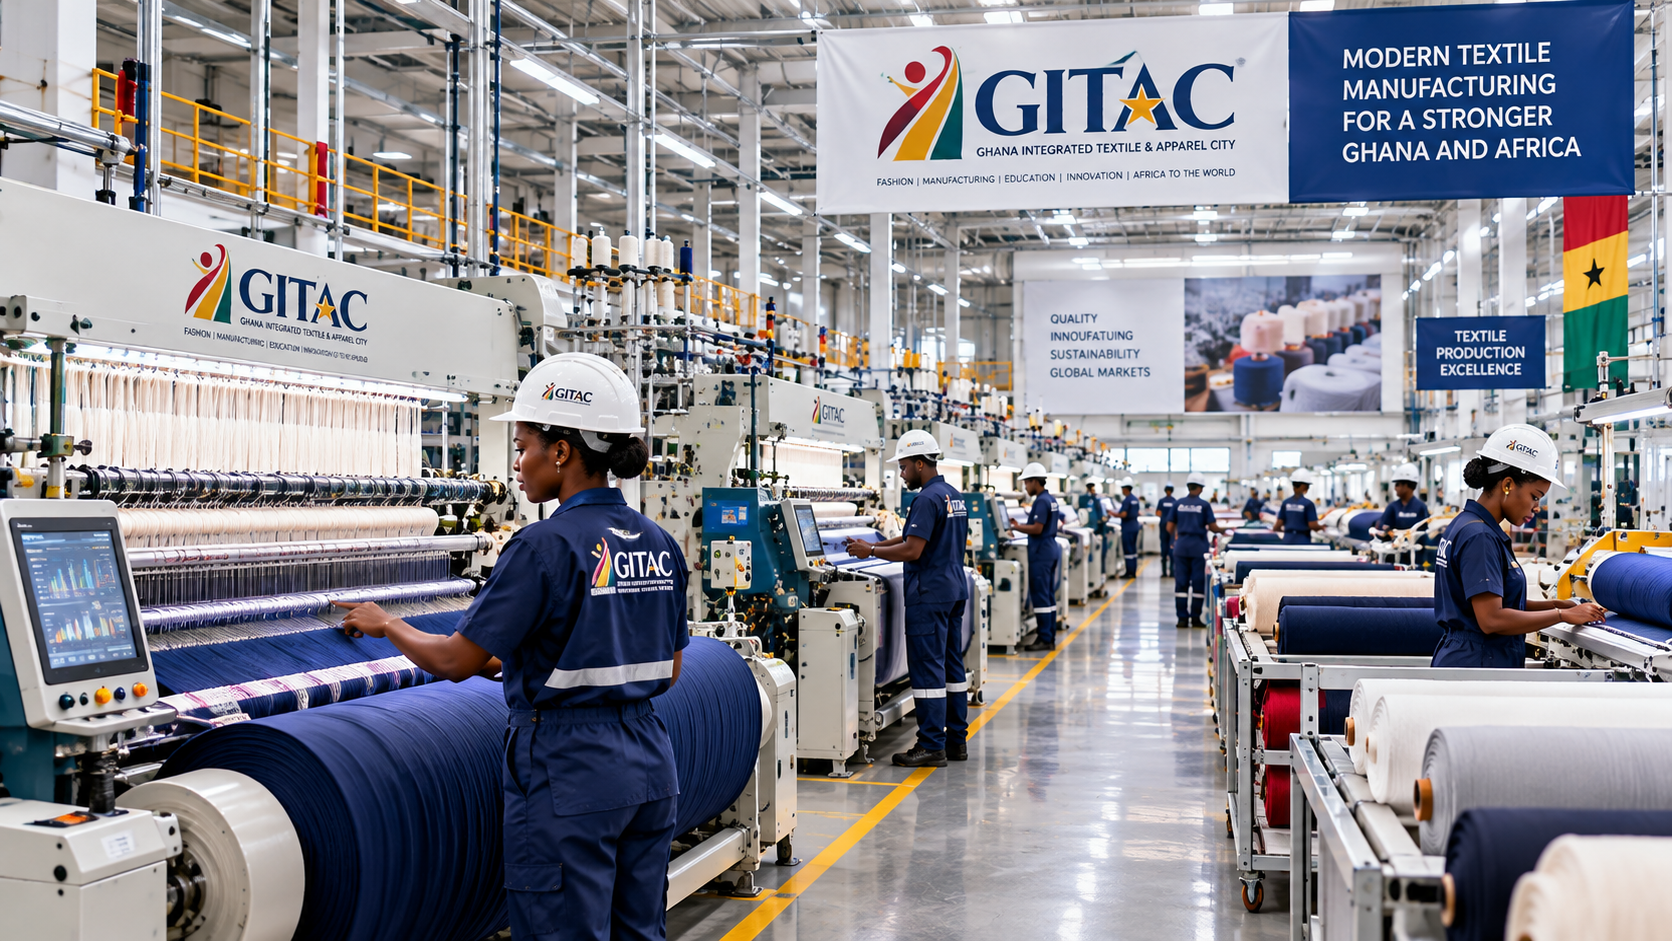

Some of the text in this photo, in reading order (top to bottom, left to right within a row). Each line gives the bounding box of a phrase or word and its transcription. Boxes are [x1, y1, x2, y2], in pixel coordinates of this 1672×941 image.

[1343, 42, 1551, 69] MODERN TEXTILE
[1343, 73, 1556, 100] MANUFACTURING
[975, 62, 1235, 136] GITAC
[1343, 105, 1553, 132] FOR A STRONGER
[976, 140, 1236, 157] GHANA INTEGRATED TEXTILE & APPAREL CITY
[1342, 136, 1582, 163] GHANA AND AFRICA
[876, 178, 914, 186] FASHION
[922, 176, 995, 185] MANUFACTURING
[1004, 174, 1056, 183] EDUCATION
[1067, 172, 1123, 181] INNOVATION
[1133, 170, 1166, 179] AFRICA
[1169, 169, 1181, 178] TO
[1184, 169, 1200, 178] THE
[1203, 168, 1236, 177] WORLD
[239, 268, 368, 332] GITAC
[1050, 314, 1098, 325] QUALITY
[1454, 330, 1507, 342] TEXTILE
[1050, 349, 1140, 360] SUSTAINABILITY
[1436, 346, 1525, 359] PRODUCTION
[1050, 367, 1151, 378] GLOBAL MARKETS
[1440, 363, 1522, 376] EXCELLENCE
[555, 388, 593, 403] GITAC
[822, 404, 845, 424] GITAC
[614, 550, 673, 578] GITAC
